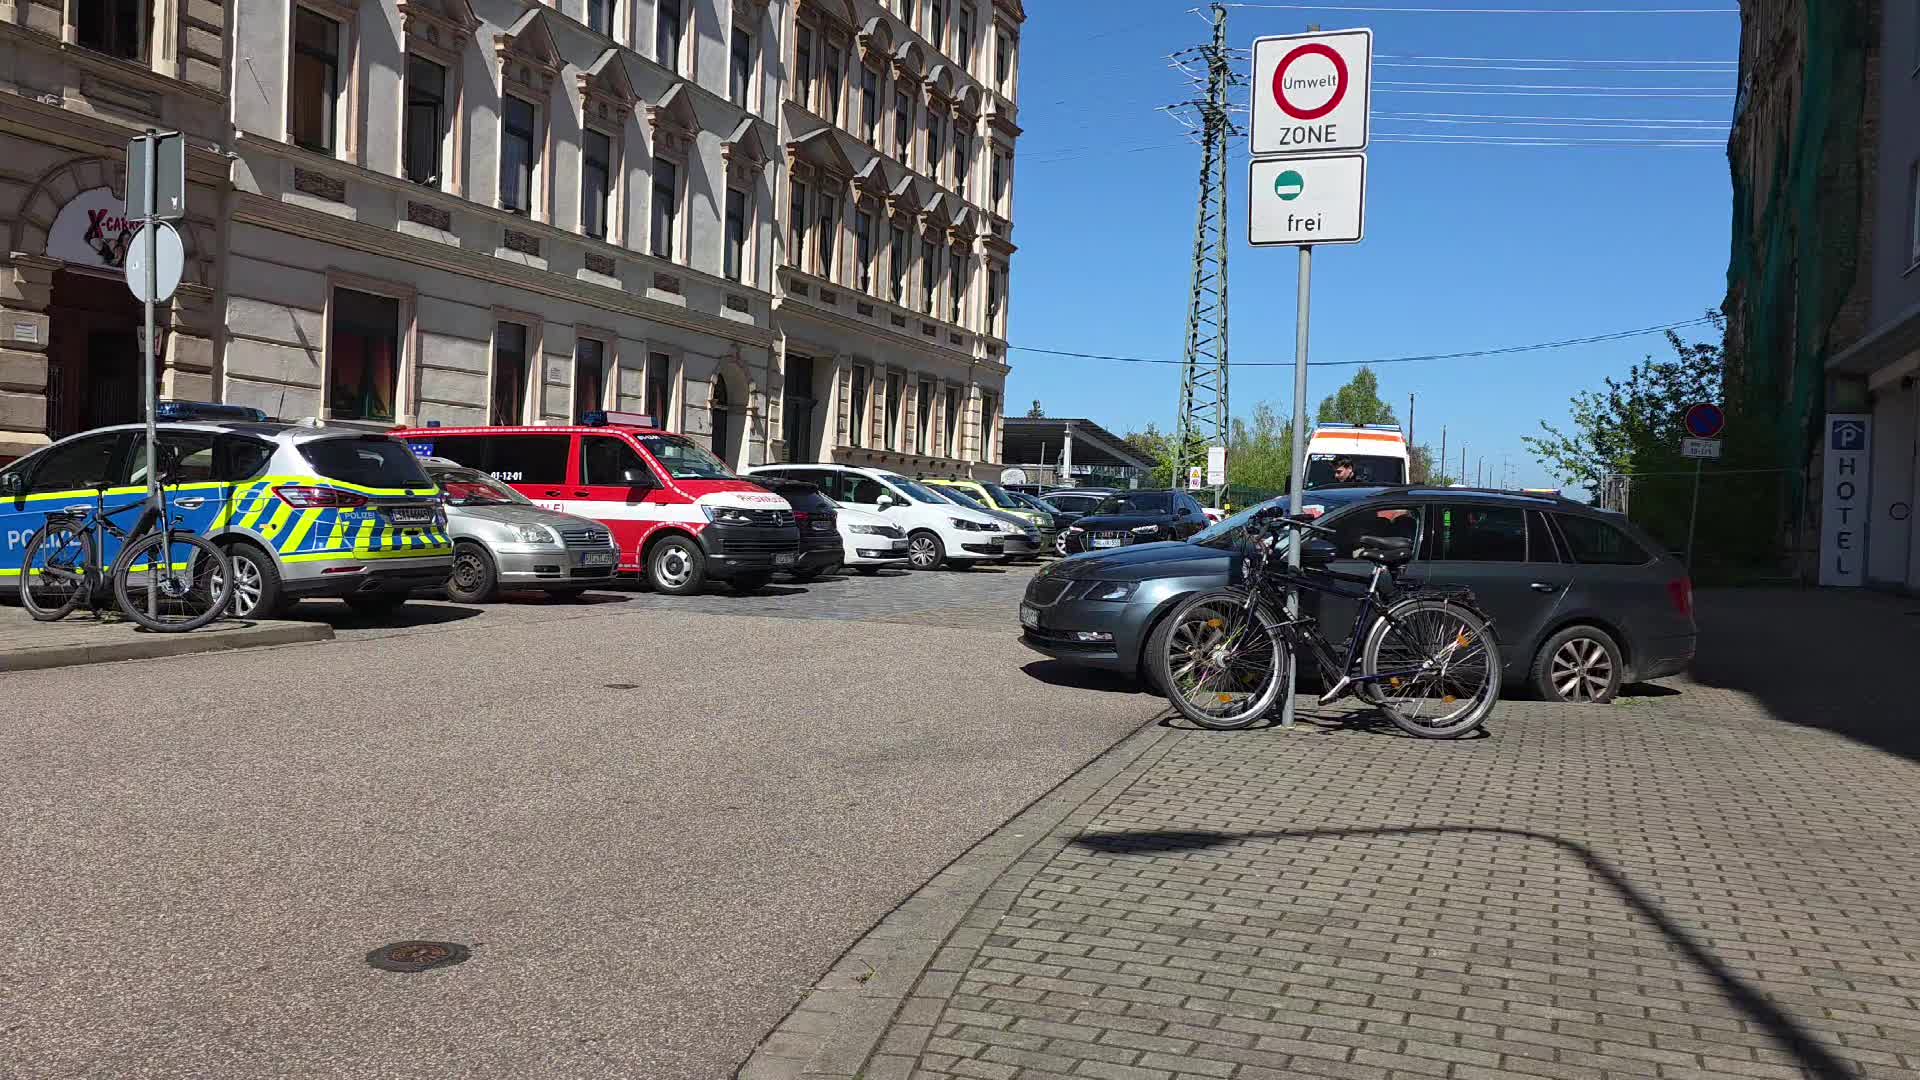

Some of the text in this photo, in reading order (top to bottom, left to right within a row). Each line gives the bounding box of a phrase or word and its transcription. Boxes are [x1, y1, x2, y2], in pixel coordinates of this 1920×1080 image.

[1283, 75, 1336, 90] Umwelt
[1279, 124, 1337, 146] ZONE
[1287, 213, 1322, 232] frei
[1842, 430, 1857, 448] P
[490, 471, 523, 482] 01-12-01
[344, 511, 377, 520] POLIZEI
[1836, 457, 1856, 575] HOTEL
[7, 528, 83, 551] POLIZ
